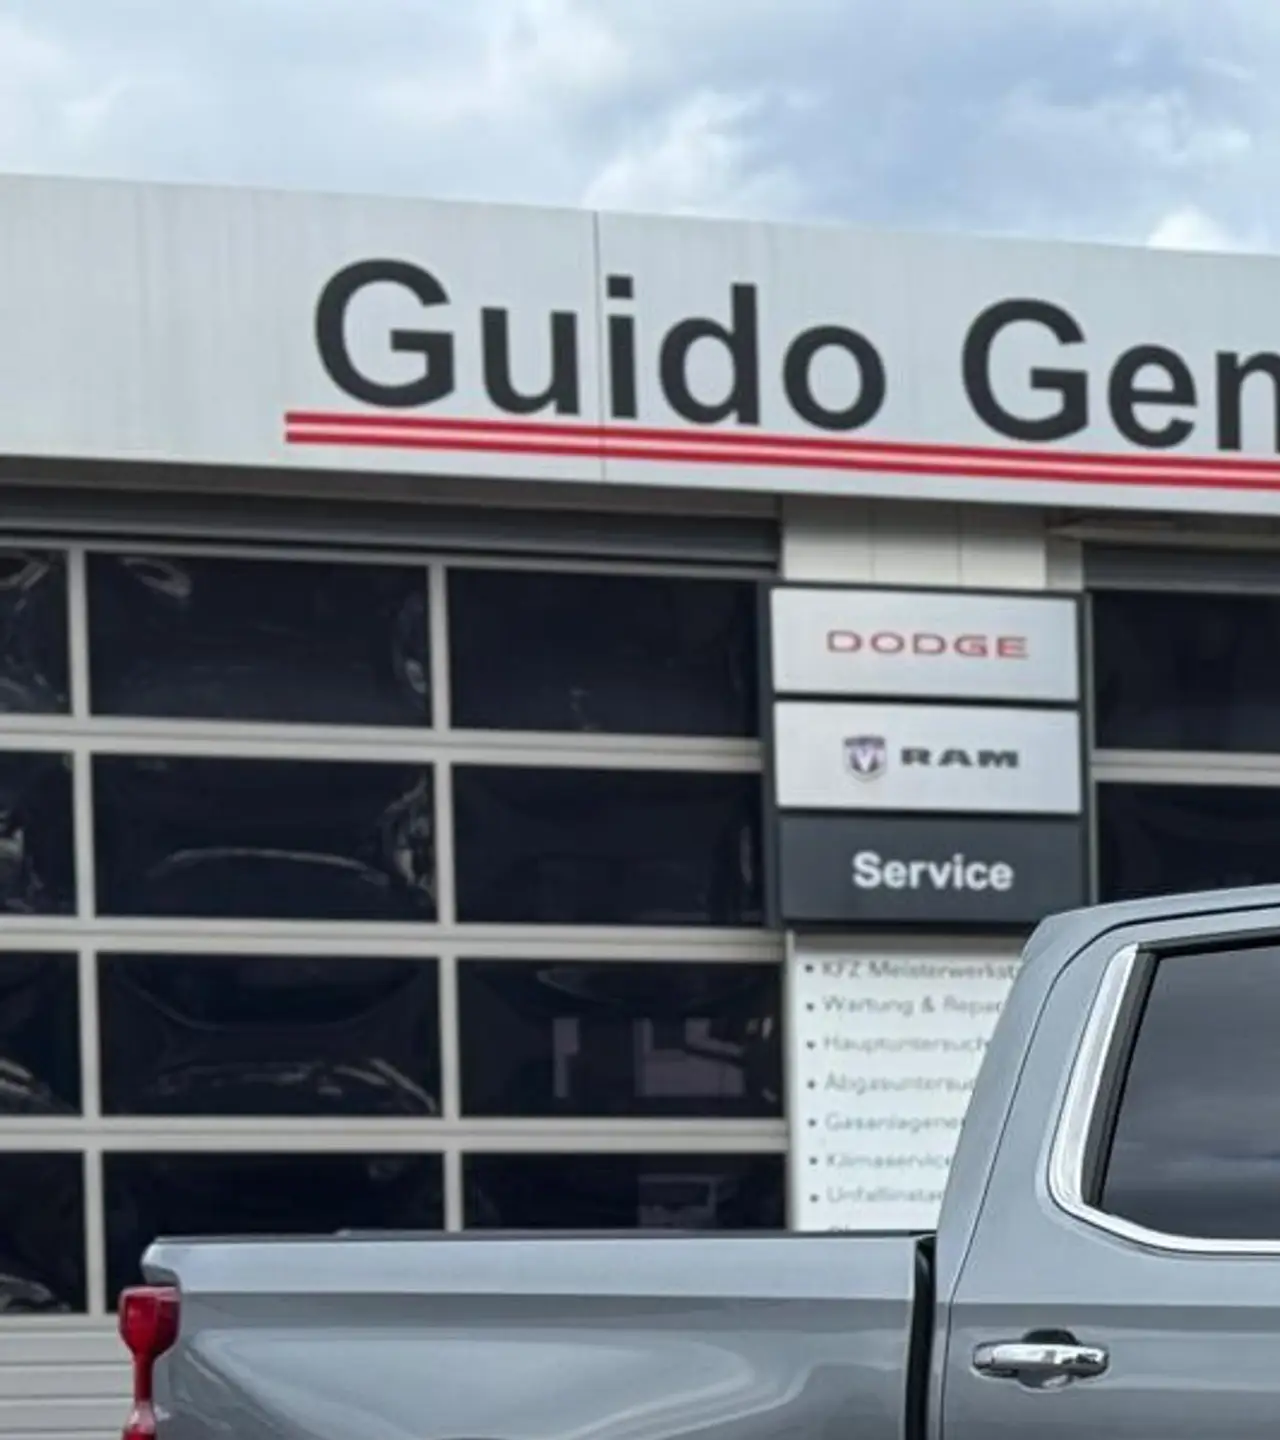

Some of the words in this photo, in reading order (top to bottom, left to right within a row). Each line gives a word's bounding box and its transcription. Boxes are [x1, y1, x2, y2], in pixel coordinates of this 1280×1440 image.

[312, 257, 887, 433] Guido
[826, 630, 1030, 659] DODGE
[901, 747, 1020, 769] RAM
[852, 851, 1014, 891] Service
[821, 959, 861, 978] KFZ
